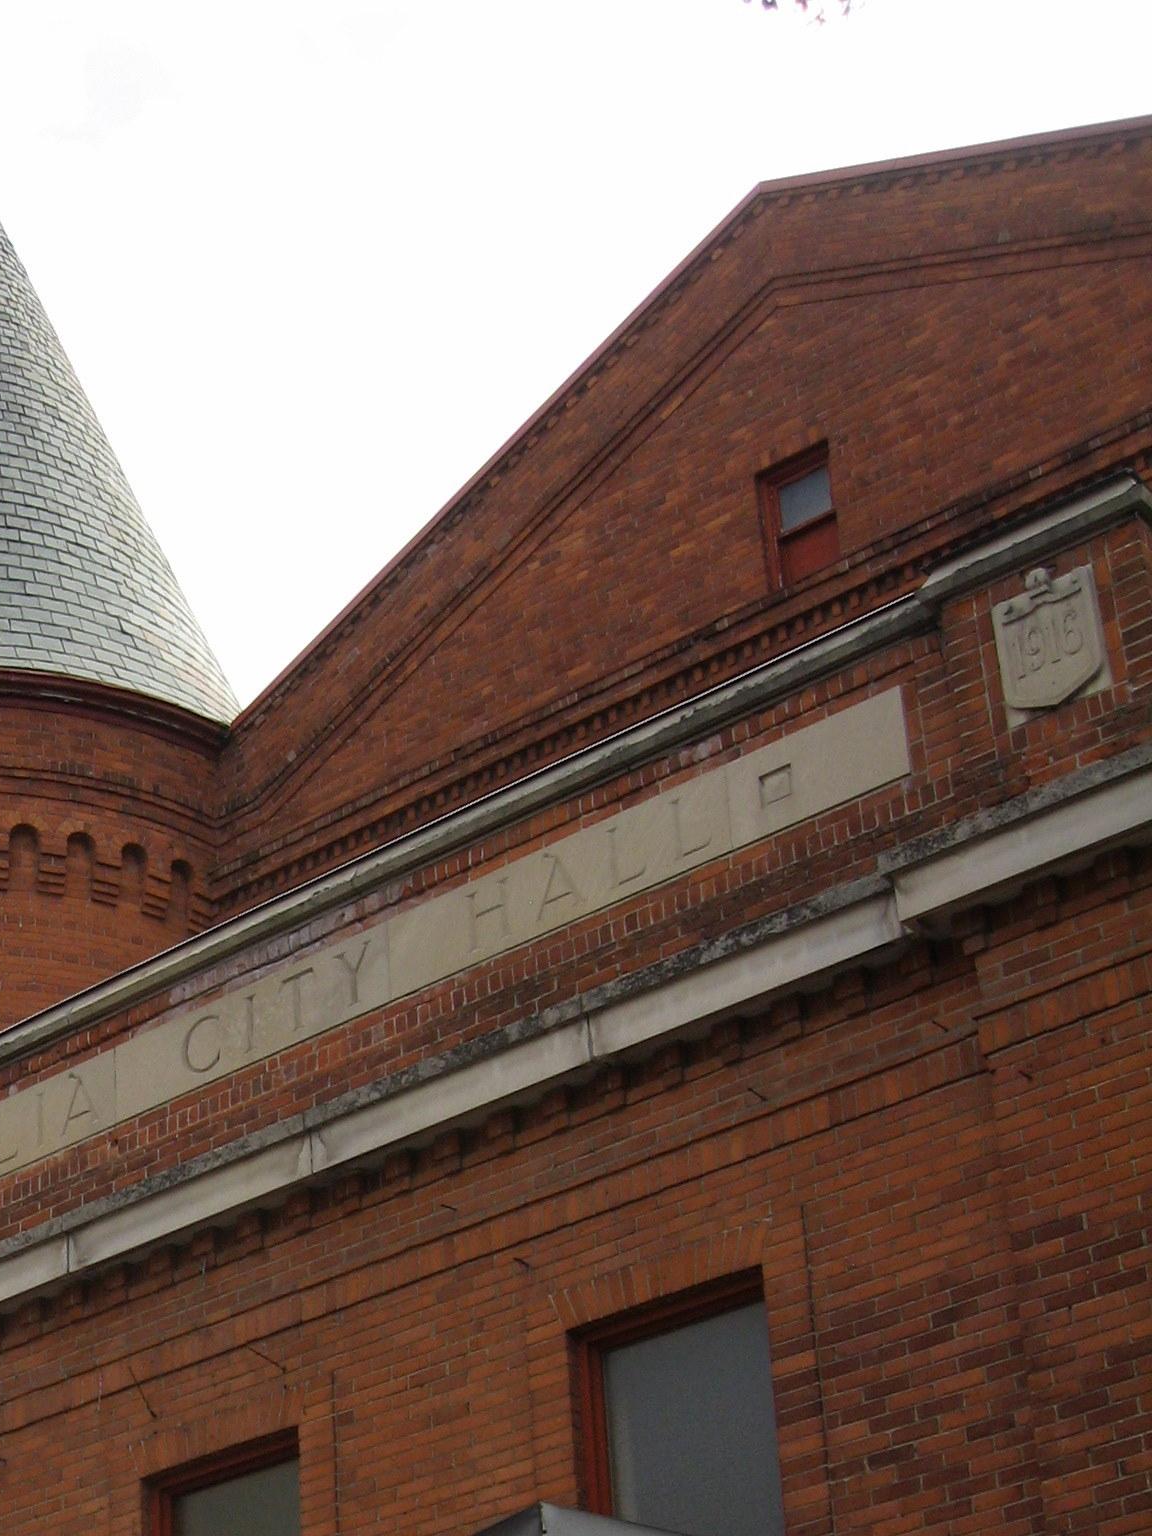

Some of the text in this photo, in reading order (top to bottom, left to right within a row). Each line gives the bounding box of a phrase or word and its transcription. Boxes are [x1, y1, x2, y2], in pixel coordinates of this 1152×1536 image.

[1012, 608, 1084, 680] 1916
[183, 939, 371, 1073] CITY
[464, 798, 713, 954] HALL
